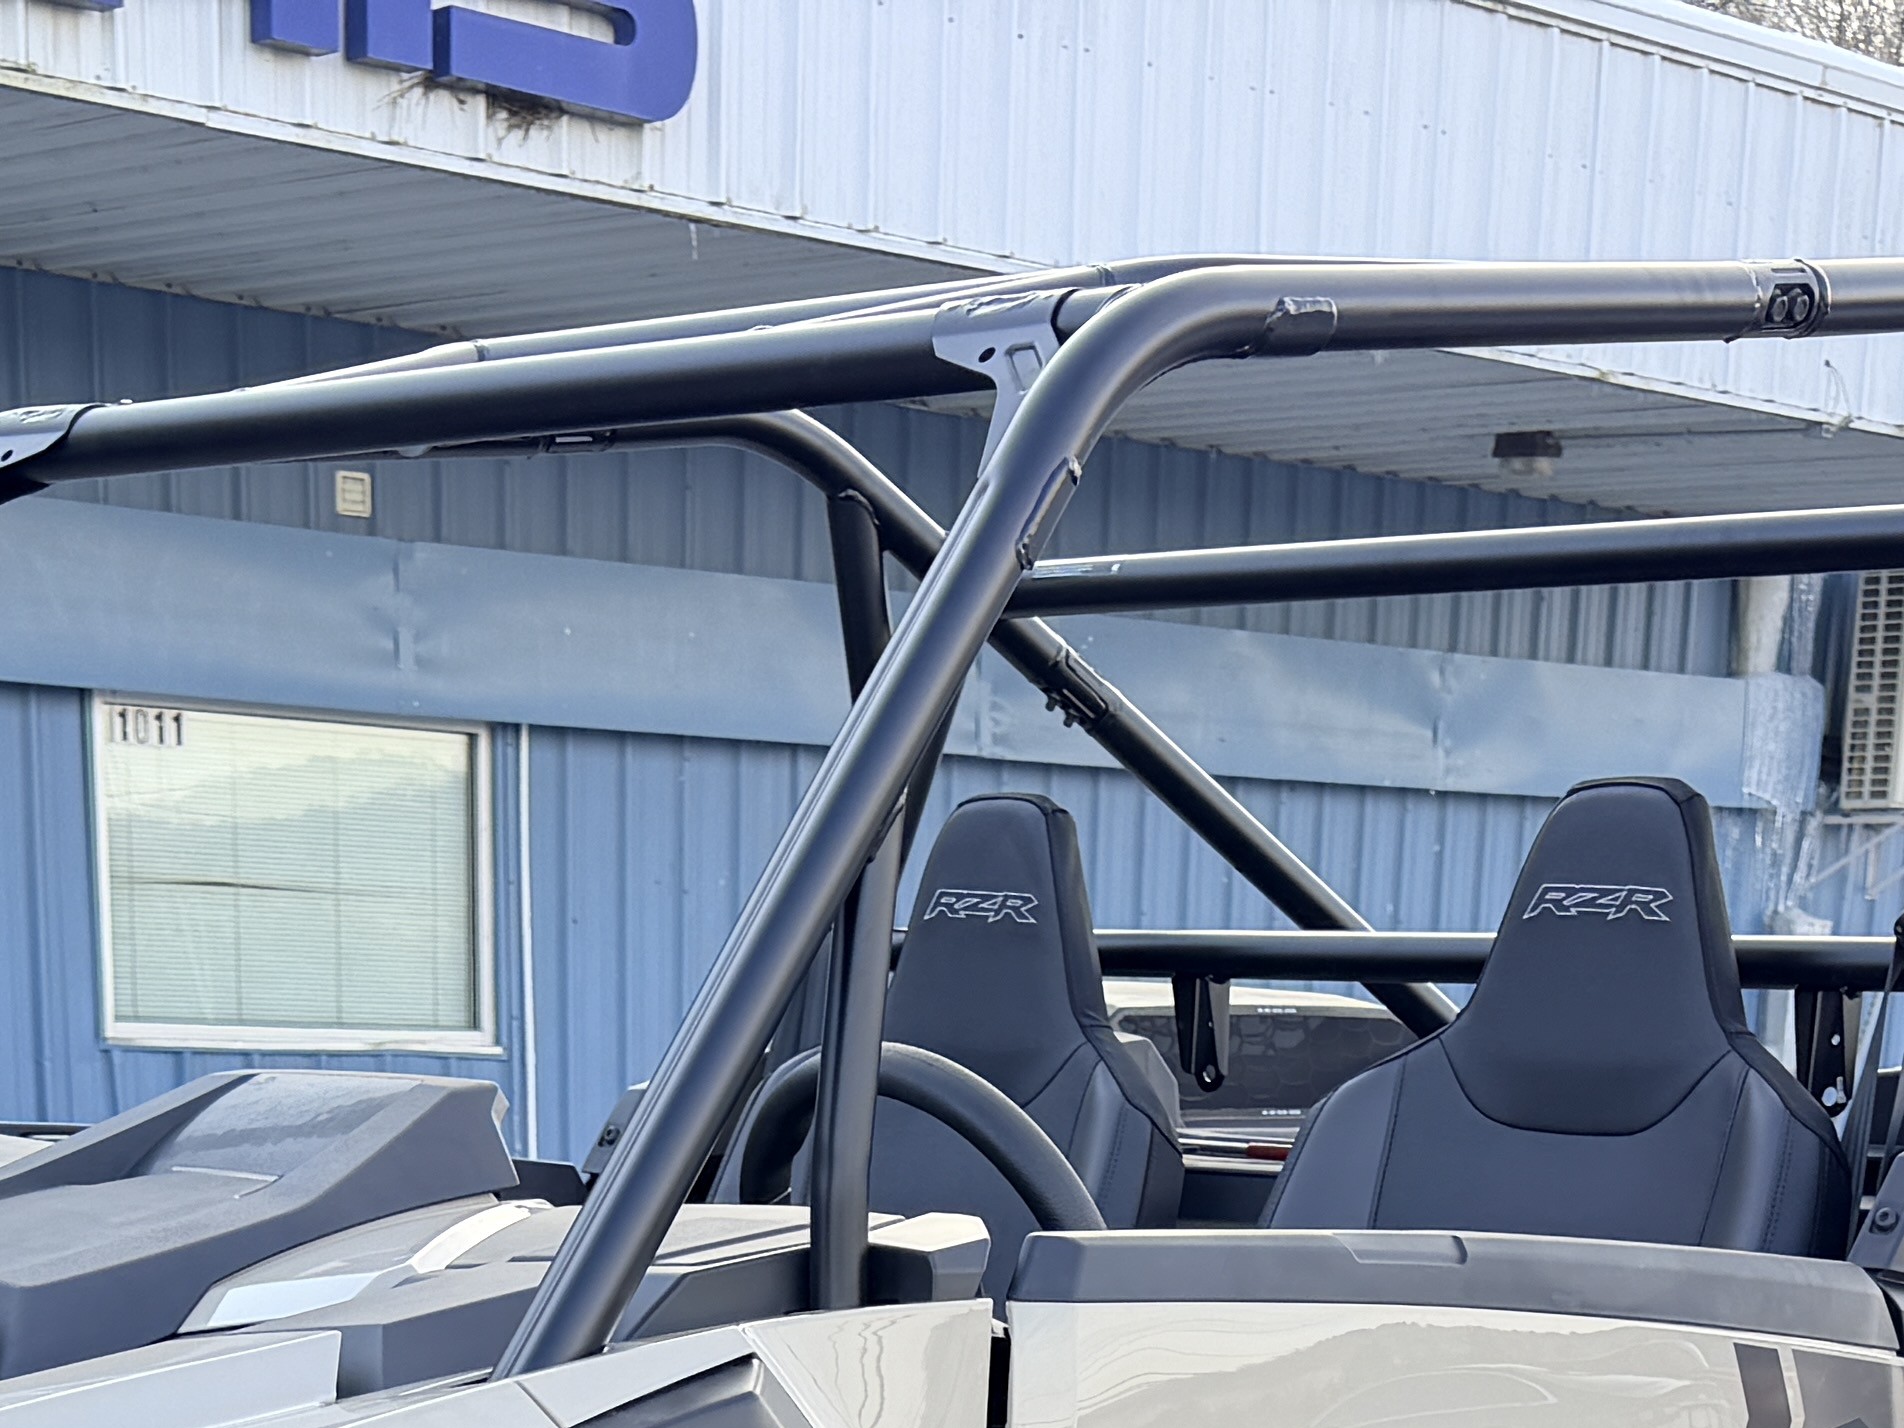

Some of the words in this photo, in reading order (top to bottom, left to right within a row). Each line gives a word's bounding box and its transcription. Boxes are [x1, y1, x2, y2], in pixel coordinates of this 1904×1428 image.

[117, 707, 183, 746] 1011
[923, 888, 1038, 925] RZR
[1523, 883, 1673, 922] RZR
